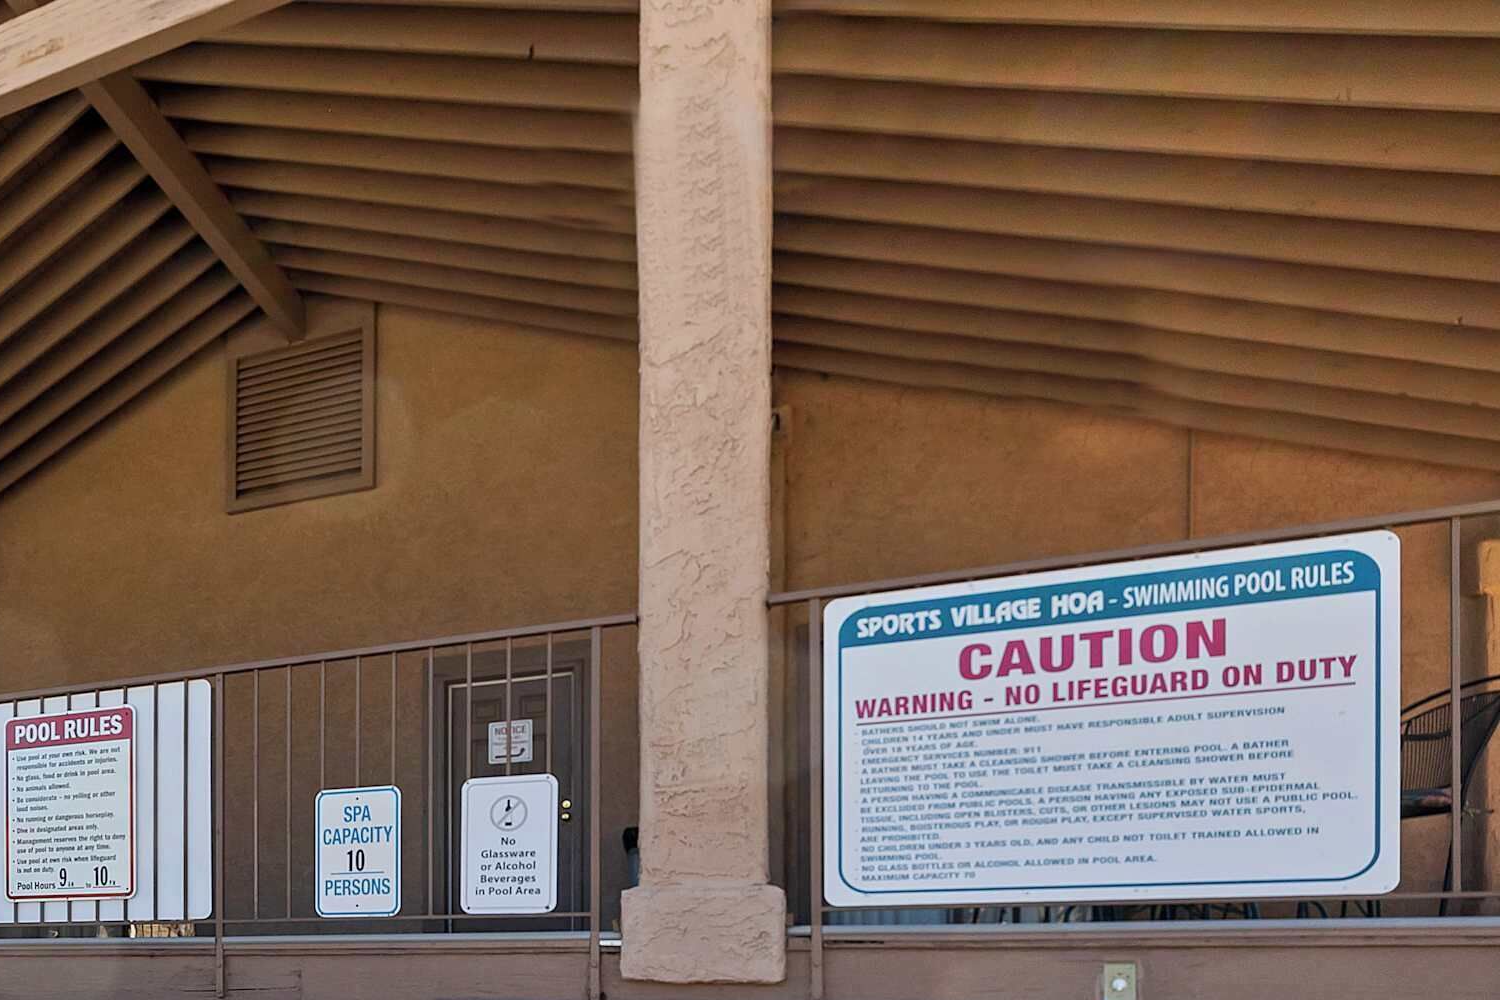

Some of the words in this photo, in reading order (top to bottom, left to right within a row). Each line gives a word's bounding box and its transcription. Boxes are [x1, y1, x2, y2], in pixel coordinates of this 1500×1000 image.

[856, 608, 942, 639] SPORTS
[950, 597, 1041, 628] VILLAGE
[1051, 590, 1104, 619] HOA
[1123, 575, 1229, 609] SWIMMING
[1234, 570, 1286, 596] POOL
[1291, 561, 1355, 590] RULES
[959, 618, 1226, 680] CAUTION
[855, 690, 973, 719] WARNING
[1005, 684, 1040, 706] NO
[1052, 669, 1209, 703] LIFEGUARD
[1222, 663, 1262, 688] ON
[1276, 655, 1357, 684] DUTY
[14, 721, 60, 744] POOL
[64, 714, 123, 739] RULES
[494, 725, 525, 736] NOICE
[860, 735, 908, 746] CHILDREN
[912, 734, 923, 742] 14
[927, 731, 958, 741] YEARS
[961, 729, 982, 738] AND
[985, 726, 1020, 736] UNDER
[1023, 723, 1052, 733] MUST
[1056, 721, 1084, 731] HAVE
[1087, 715, 1162, 728] RESPONSIBLE
[1166, 712, 1202, 722] ADULT
[1206, 705, 1285, 719] SUPERVISION
[859, 775, 899, 784] LEAVING
[903, 773, 920, 782] THE
[924, 772, 947, 780] POOL
[953, 770, 965, 779] TO
[968, 769, 987, 778] USE
[991, 768, 1009, 776] THE
[1014, 765, 1048, 775] TOILET
[1052, 763, 1081, 772] MUST
[1086, 761, 1112, 770] TAKE
[1116, 760, 1124, 768] A
[1127, 756, 1191, 768] CLEANSING
[1194, 752, 1244, 764] SHOWER
[1247, 749, 1293, 760] BEFORE
[861, 767, 867, 775] A
[870, 764, 907, 774] BATHER
[910, 762, 937, 771] MUST
[942, 760, 965, 769] TAKE
[969, 760, 975, 768] A
[978, 756, 1037, 767] CLEANSING
[1040, 752, 1085, 763] SHOWER
[1088, 749, 1130, 760] BEFORE
[1133, 745, 1190, 757] ENTERING
[1230, 742, 1238, 750] A
[1242, 738, 1289, 750] BATHER
[859, 806, 871, 814] BE
[875, 803, 924, 813] EXCLUDED
[927, 801, 956, 810] FROM
[958, 799, 994, 808] PUBLIC
[1037, 796, 1045, 804] A
[1048, 794, 1091, 804] PERSON
[1094, 791, 1135, 801] HAVING
[1139, 790, 1161, 799] ANY
[1165, 787, 1217, 798] EXPOSED
[1221, 781, 1319, 795] SUB-EPIDERMAL
[861, 796, 867, 804] A
[870, 794, 908, 803] PERSON
[911, 792, 948, 801] HAVING
[951, 791, 957, 799] A
[961, 786, 1043, 798] COMMUNICABLE
[1046, 783, 1091, 793] DISEASE
[1096, 778, 1184, 791] TRANSMISSIBLE
[1189, 777, 1204, 785] BY
[1208, 774, 1248, 784] WATER
[1252, 772, 1285, 782] MUST
[343, 805, 371, 823] SPA
[898, 811, 951, 821] INCLUDING
[953, 810, 980, 819] OPEN
[1072, 804, 1087, 813] OR
[1090, 802, 1126, 812] OTHER
[1128, 800, 1176, 810] LESIONS
[1179, 798, 1204, 808] MAY
[1208, 797, 1231, 806] NOT
[1235, 796, 1258, 805] USE
[1262, 795, 1270, 803] A
[1273, 792, 1318, 803] PUBLIC
[323, 825, 392, 845] CAPACITY
[501, 837, 516, 846] No
[877, 842, 925, 852] CHILDREN
[927, 841, 961, 850] UNDER
[974, 839, 1006, 848] YEARS
[1036, 837, 1058, 845] AND
[1062, 836, 1083, 844] ANY
[1086, 834, 1119, 843] CHILD
[1122, 833, 1144, 842] NOT
[1149, 832, 1186, 841] TOILET
[1191, 829, 1241, 839] TRAINED
[1244, 827, 1302, 837] ALLOWED
[1306, 826, 1319, 835] IN
[346, 849, 365, 872] 10
[480, 849, 536, 859] Glassware
[495, 860, 536, 870] Alcohol
[860, 864, 874, 872] NO
[877, 863, 908, 871] GLASS
[911, 861, 954, 870] BOTTLES
[974, 859, 1019, 868] ALCOHOL
[1023, 857, 1074, 866] ALLOWED
[1077, 857, 1089, 865] IN
[1091, 855, 1119, 864] POOL
[17, 882, 33, 890] Pool
[34, 881, 56, 890] Hours
[59, 868, 67, 887] 9
[93, 866, 108, 886] 10
[325, 878, 391, 896] PERSONS
[480, 874, 536, 885] Beverages
[475, 886, 485, 895] in
[489, 886, 512, 895] Pool
[515, 886, 541, 895] Area
